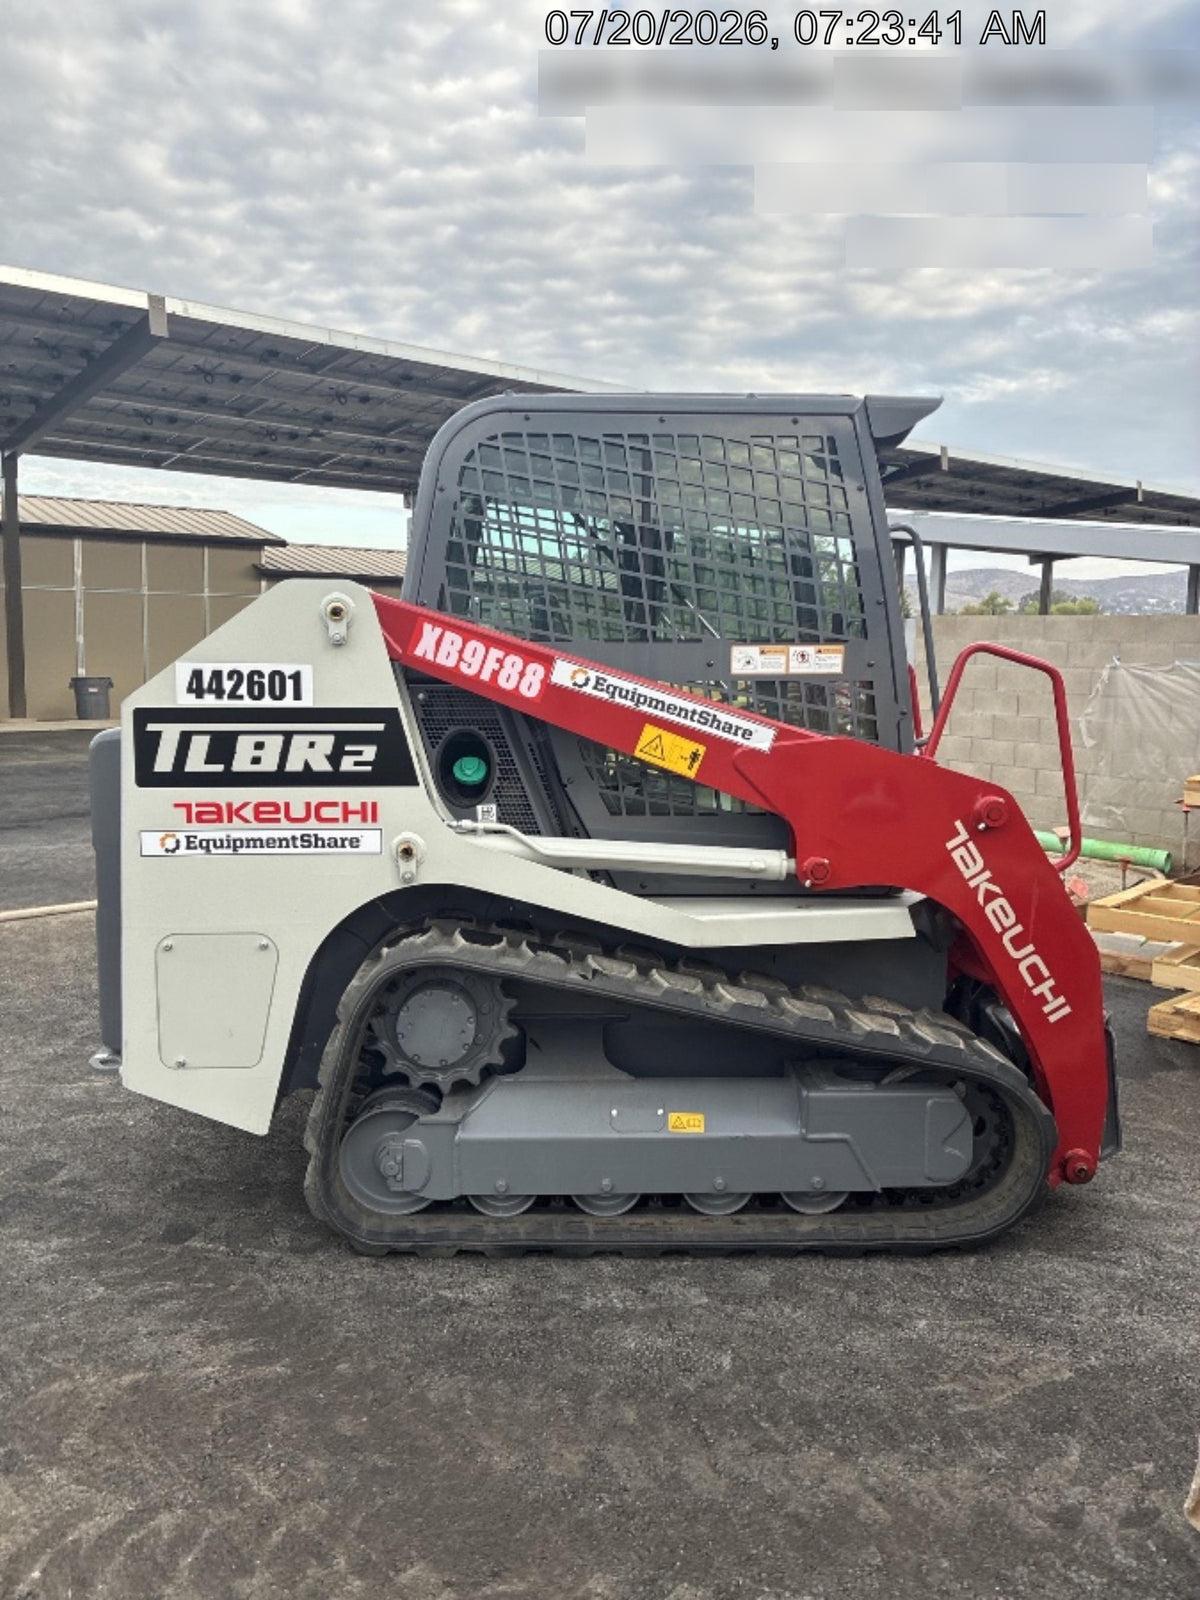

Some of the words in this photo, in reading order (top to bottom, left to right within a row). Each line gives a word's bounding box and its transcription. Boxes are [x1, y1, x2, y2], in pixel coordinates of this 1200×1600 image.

[413, 621, 545, 699] XB9F88
[187, 669, 303, 701] 442601
[592, 676, 754, 742] EquipmentShare
[173, 801, 379, 824] TAKEUCHI
[184, 833, 361, 853] EquipmentShare
[945, 819, 1072, 1024] TAKEUCHI
